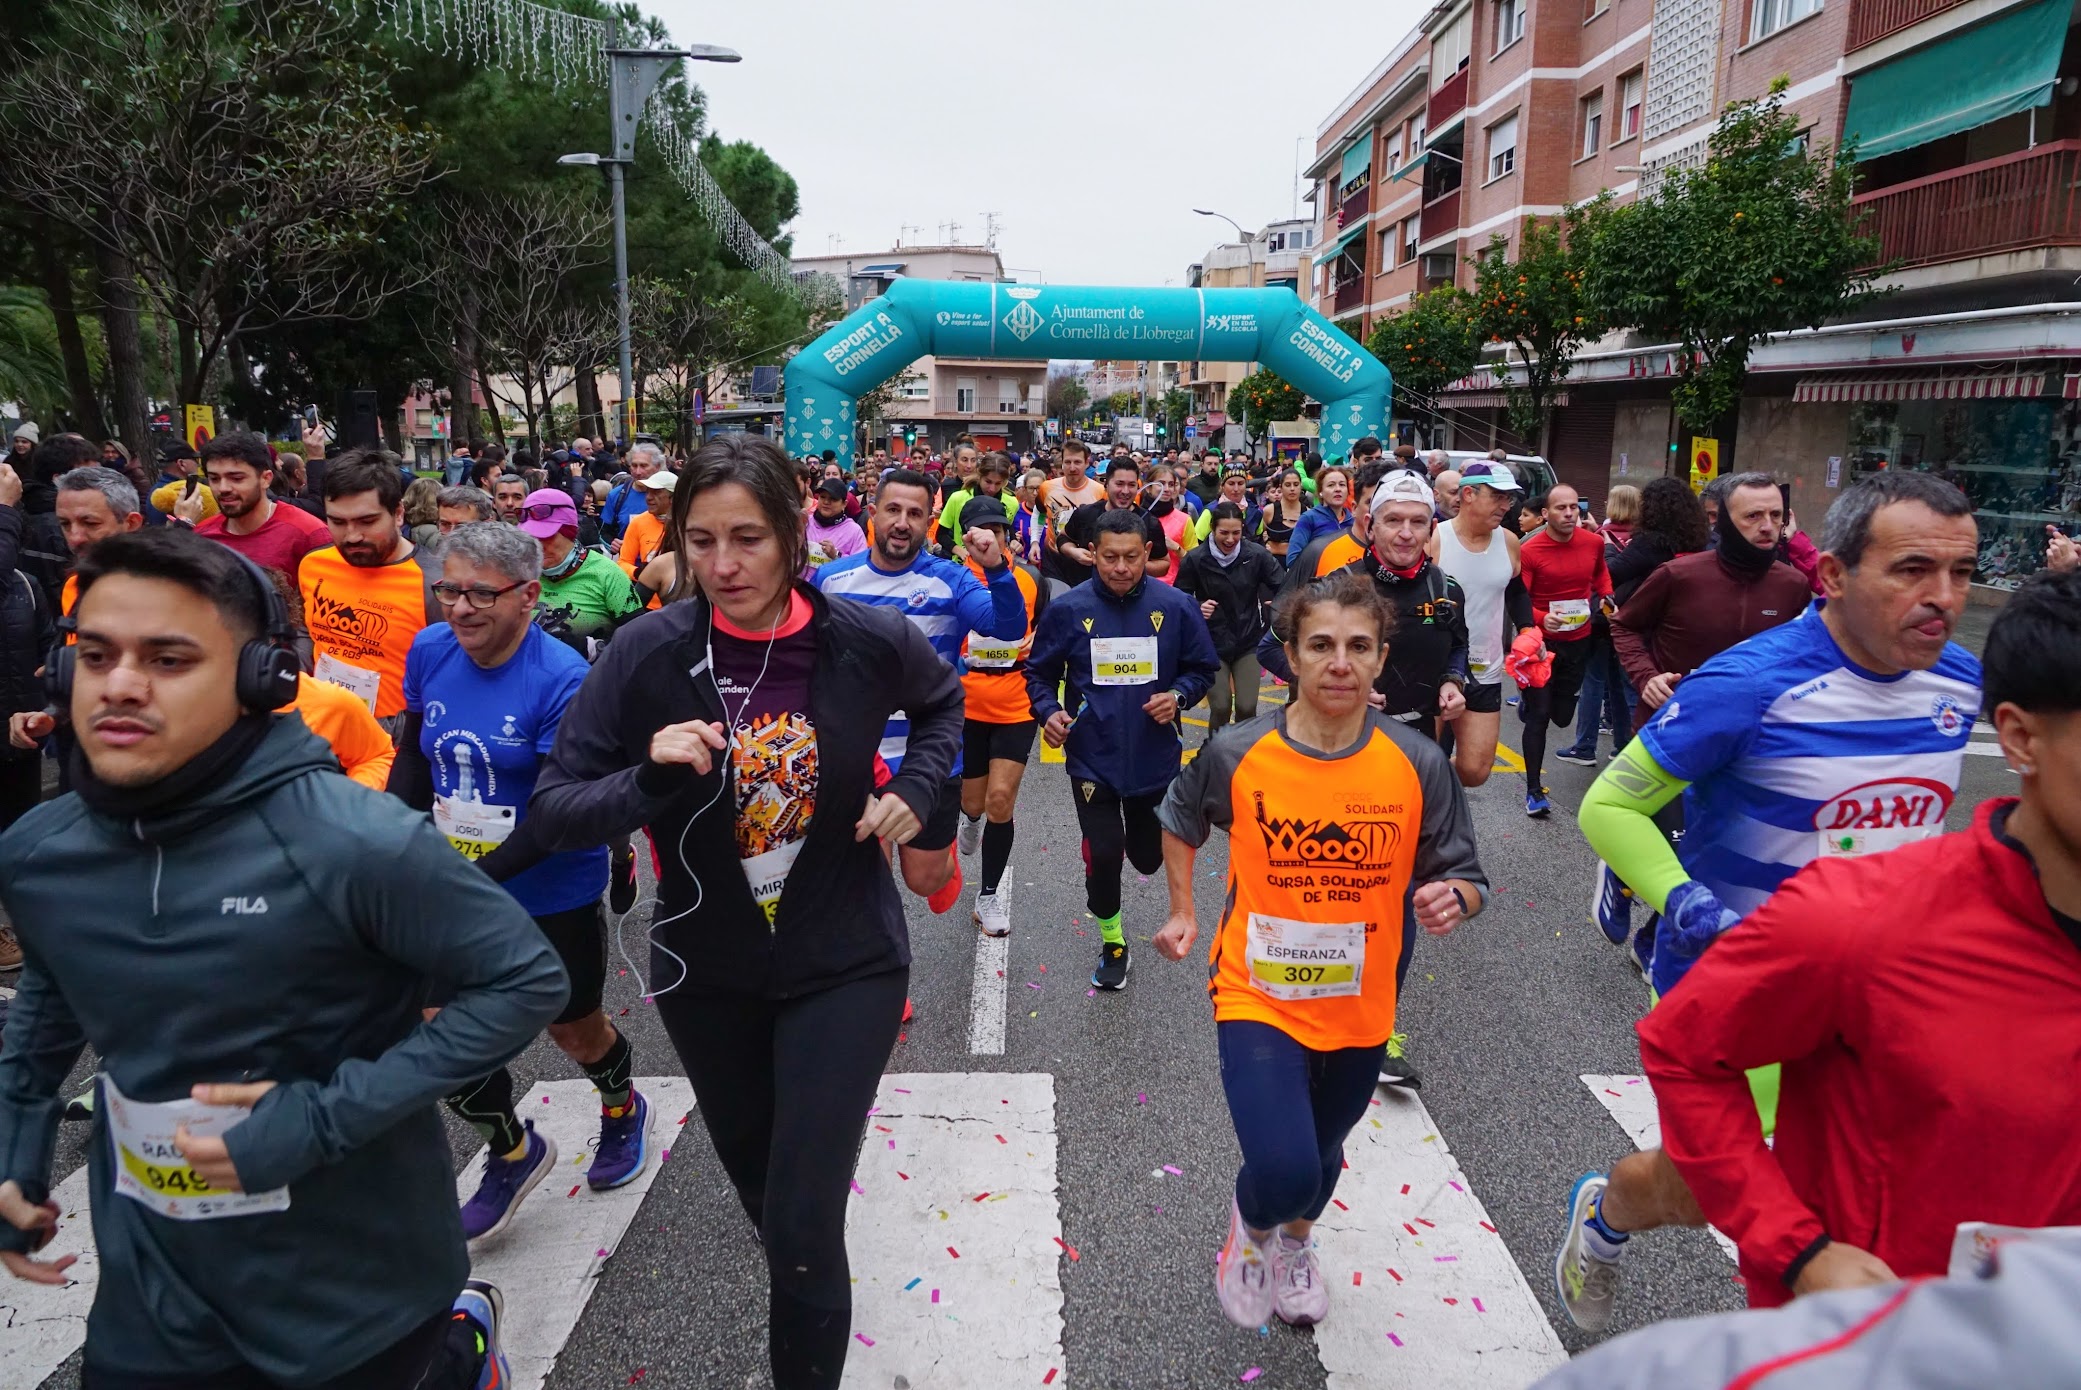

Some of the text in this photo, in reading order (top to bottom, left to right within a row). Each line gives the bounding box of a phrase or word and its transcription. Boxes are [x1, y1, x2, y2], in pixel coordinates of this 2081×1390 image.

[1051, 304, 1145, 322] Ajuntament de
[823, 312, 892, 364] ESPORT A
[1050, 323, 1195, 343] Cornellà de Llobregat
[834, 324, 903, 376] CORNELLÀ
[1300, 319, 1363, 371] ESPORT A
[1289, 331, 1354, 383] CORNELLÀ
[358, 597, 394, 614] SOLIDARIS
[328, 646, 339, 655] DE
[986, 650, 1009, 659] 1655
[1114, 663, 1137, 674] 904
[442, 729, 460, 740] CAN
[1345, 803, 1404, 814] SOLIDARIS
[1825, 795, 1935, 829] DANI
[455, 825, 483, 837] JORDI
[455, 840, 483, 855] 274
[1267, 874, 1315, 888] CURSA
[1303, 890, 1361, 903] DE REIS
[221, 896, 268, 915] FILA
[1267, 945, 1347, 960] ESPERANZA
[1284, 966, 1325, 982] 307
